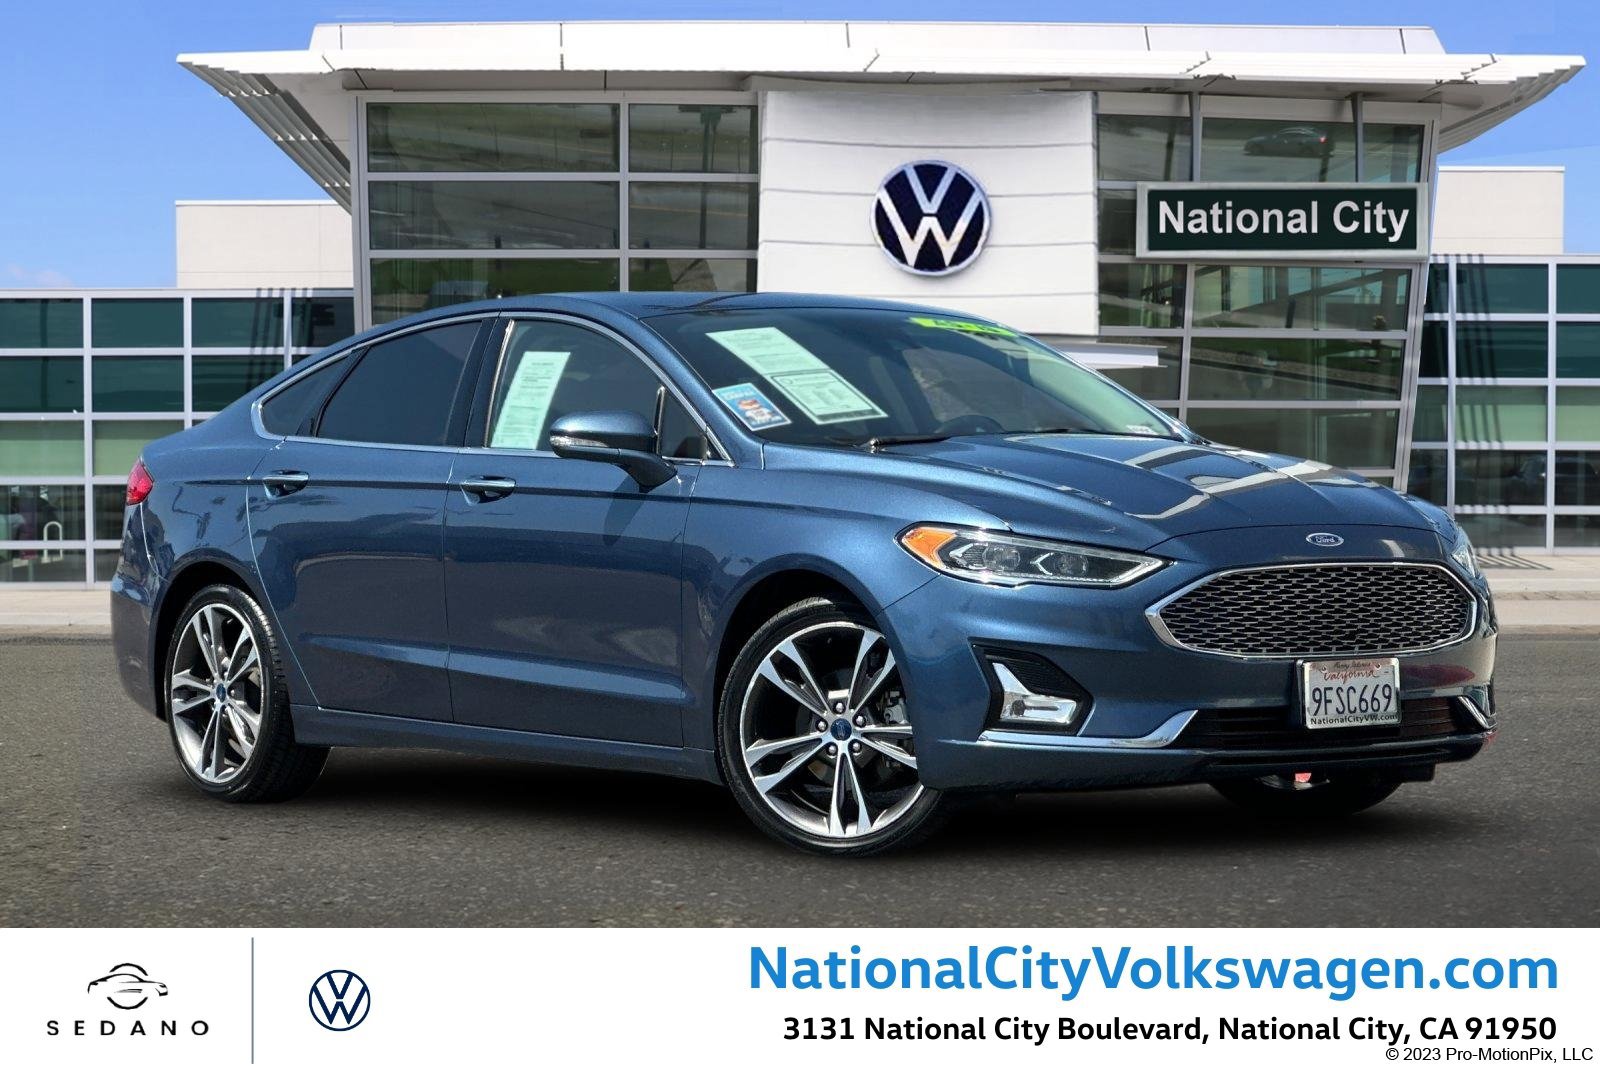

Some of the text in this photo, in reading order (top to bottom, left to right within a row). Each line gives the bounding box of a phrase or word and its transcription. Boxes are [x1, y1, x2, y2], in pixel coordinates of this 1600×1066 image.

[1158, 200, 1410, 243] National City
[1323, 669, 1378, 684] California
[1311, 683, 1392, 717] 9FSC669
[1310, 712, 1400, 725] NationalCityVW.com
